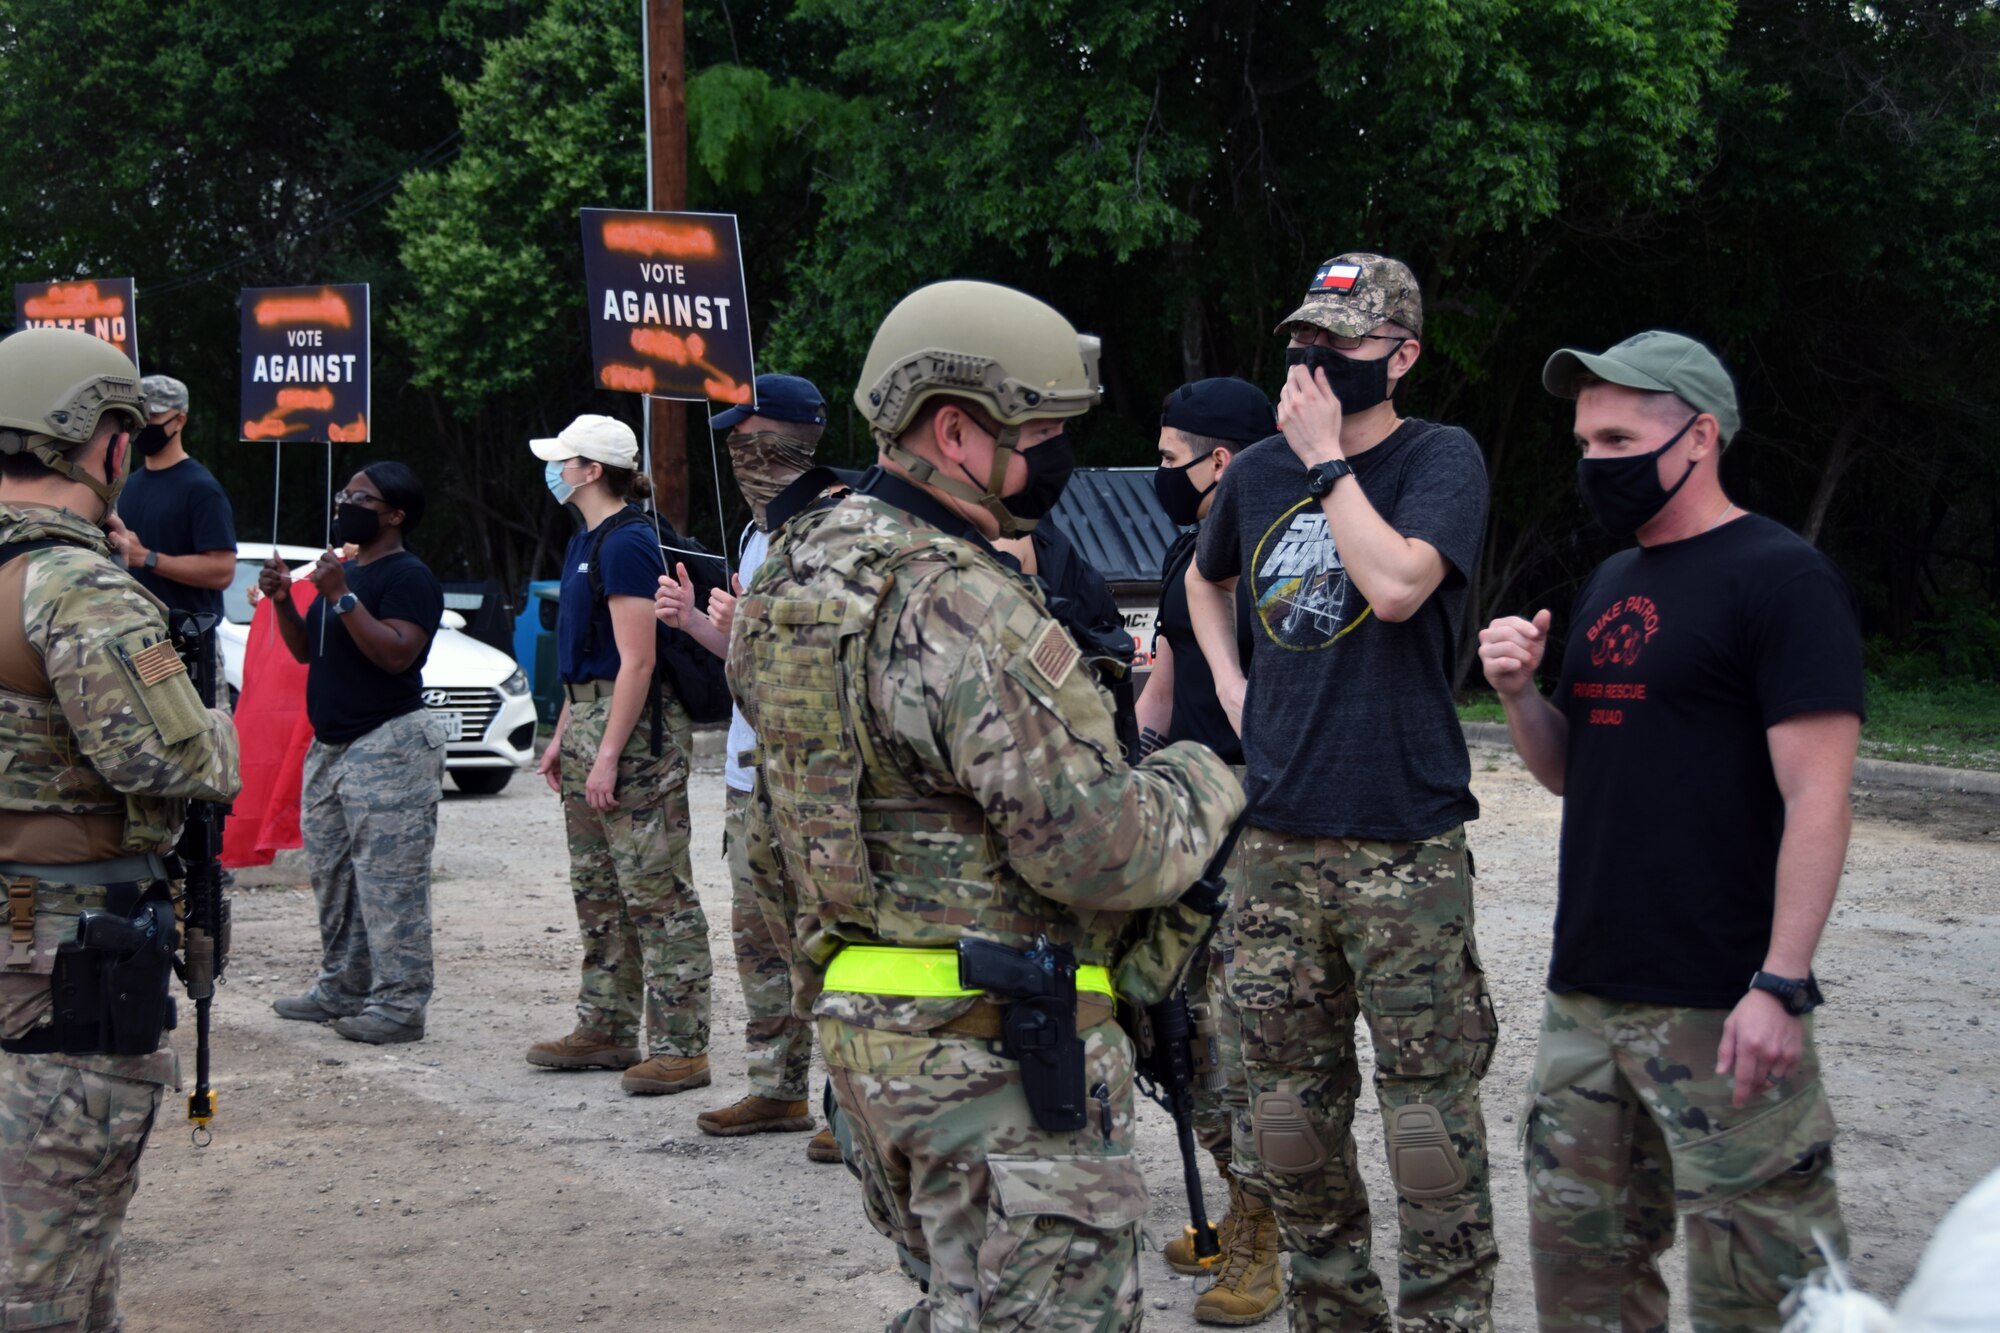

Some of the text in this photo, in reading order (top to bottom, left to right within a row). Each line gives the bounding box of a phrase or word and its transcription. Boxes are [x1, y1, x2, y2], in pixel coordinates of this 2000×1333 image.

[640, 263, 686, 285] VOTE
[603, 289, 731, 331] AGAINST
[94, 316, 126, 342] NO
[287, 330, 323, 347] VOTE
[252, 354, 356, 383] AGAINST
[1281, 513, 1334, 542] STA
[1258, 539, 1345, 578] WAR
[1586, 595, 1659, 644] BIKE PATROL
[1573, 683, 1647, 699] RIVER RESCUE
[1590, 709, 1622, 725] SQUAD
